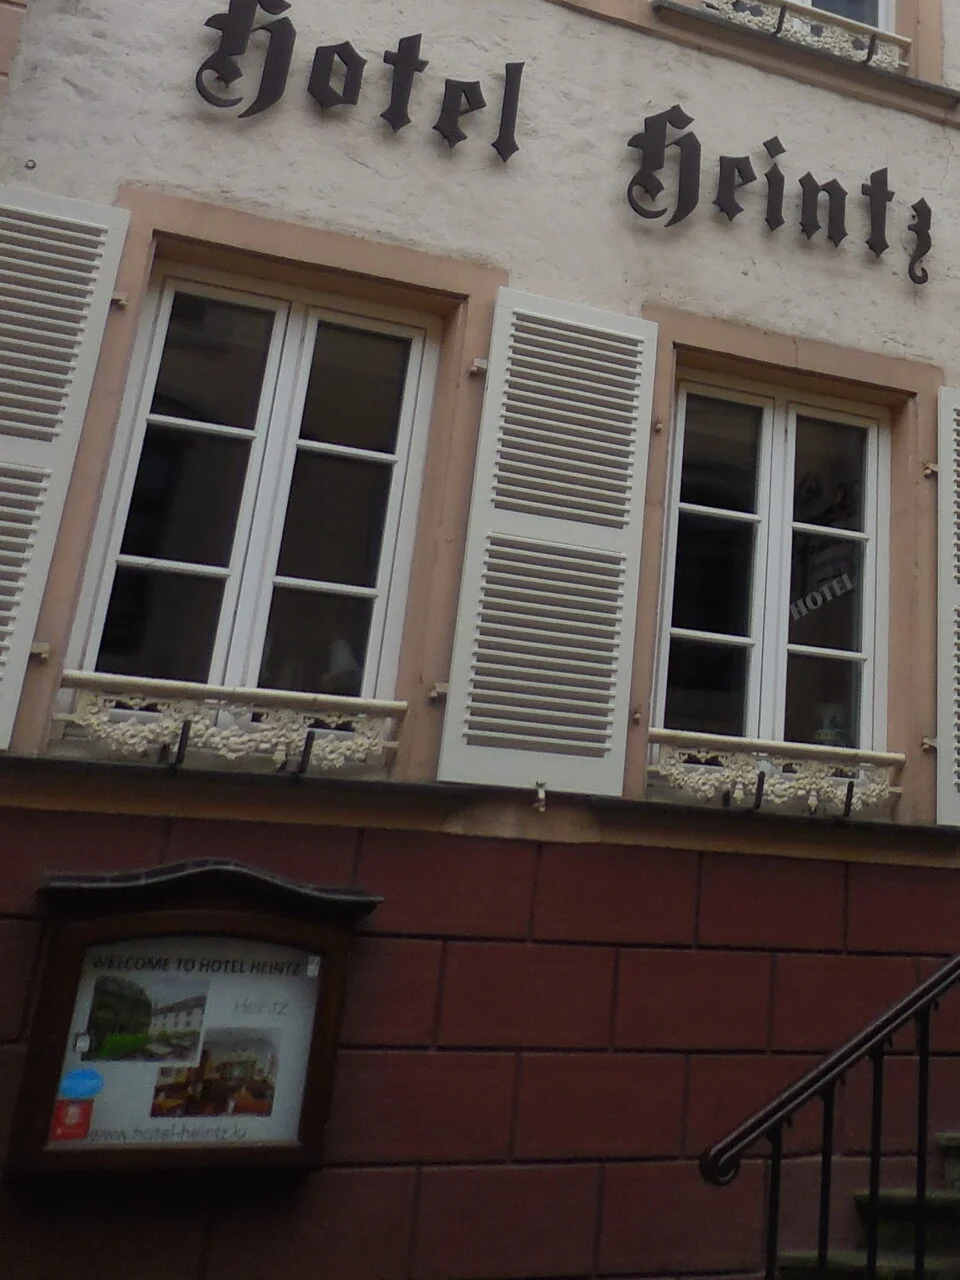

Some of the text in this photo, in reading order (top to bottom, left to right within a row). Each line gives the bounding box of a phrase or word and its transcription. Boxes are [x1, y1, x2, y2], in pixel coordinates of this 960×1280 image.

[627, 104, 932, 284] Heintz
[790, 573, 855, 620] HOTEL
[93, 956, 301, 976] WELCOME TO HOTEL HEINTZ
